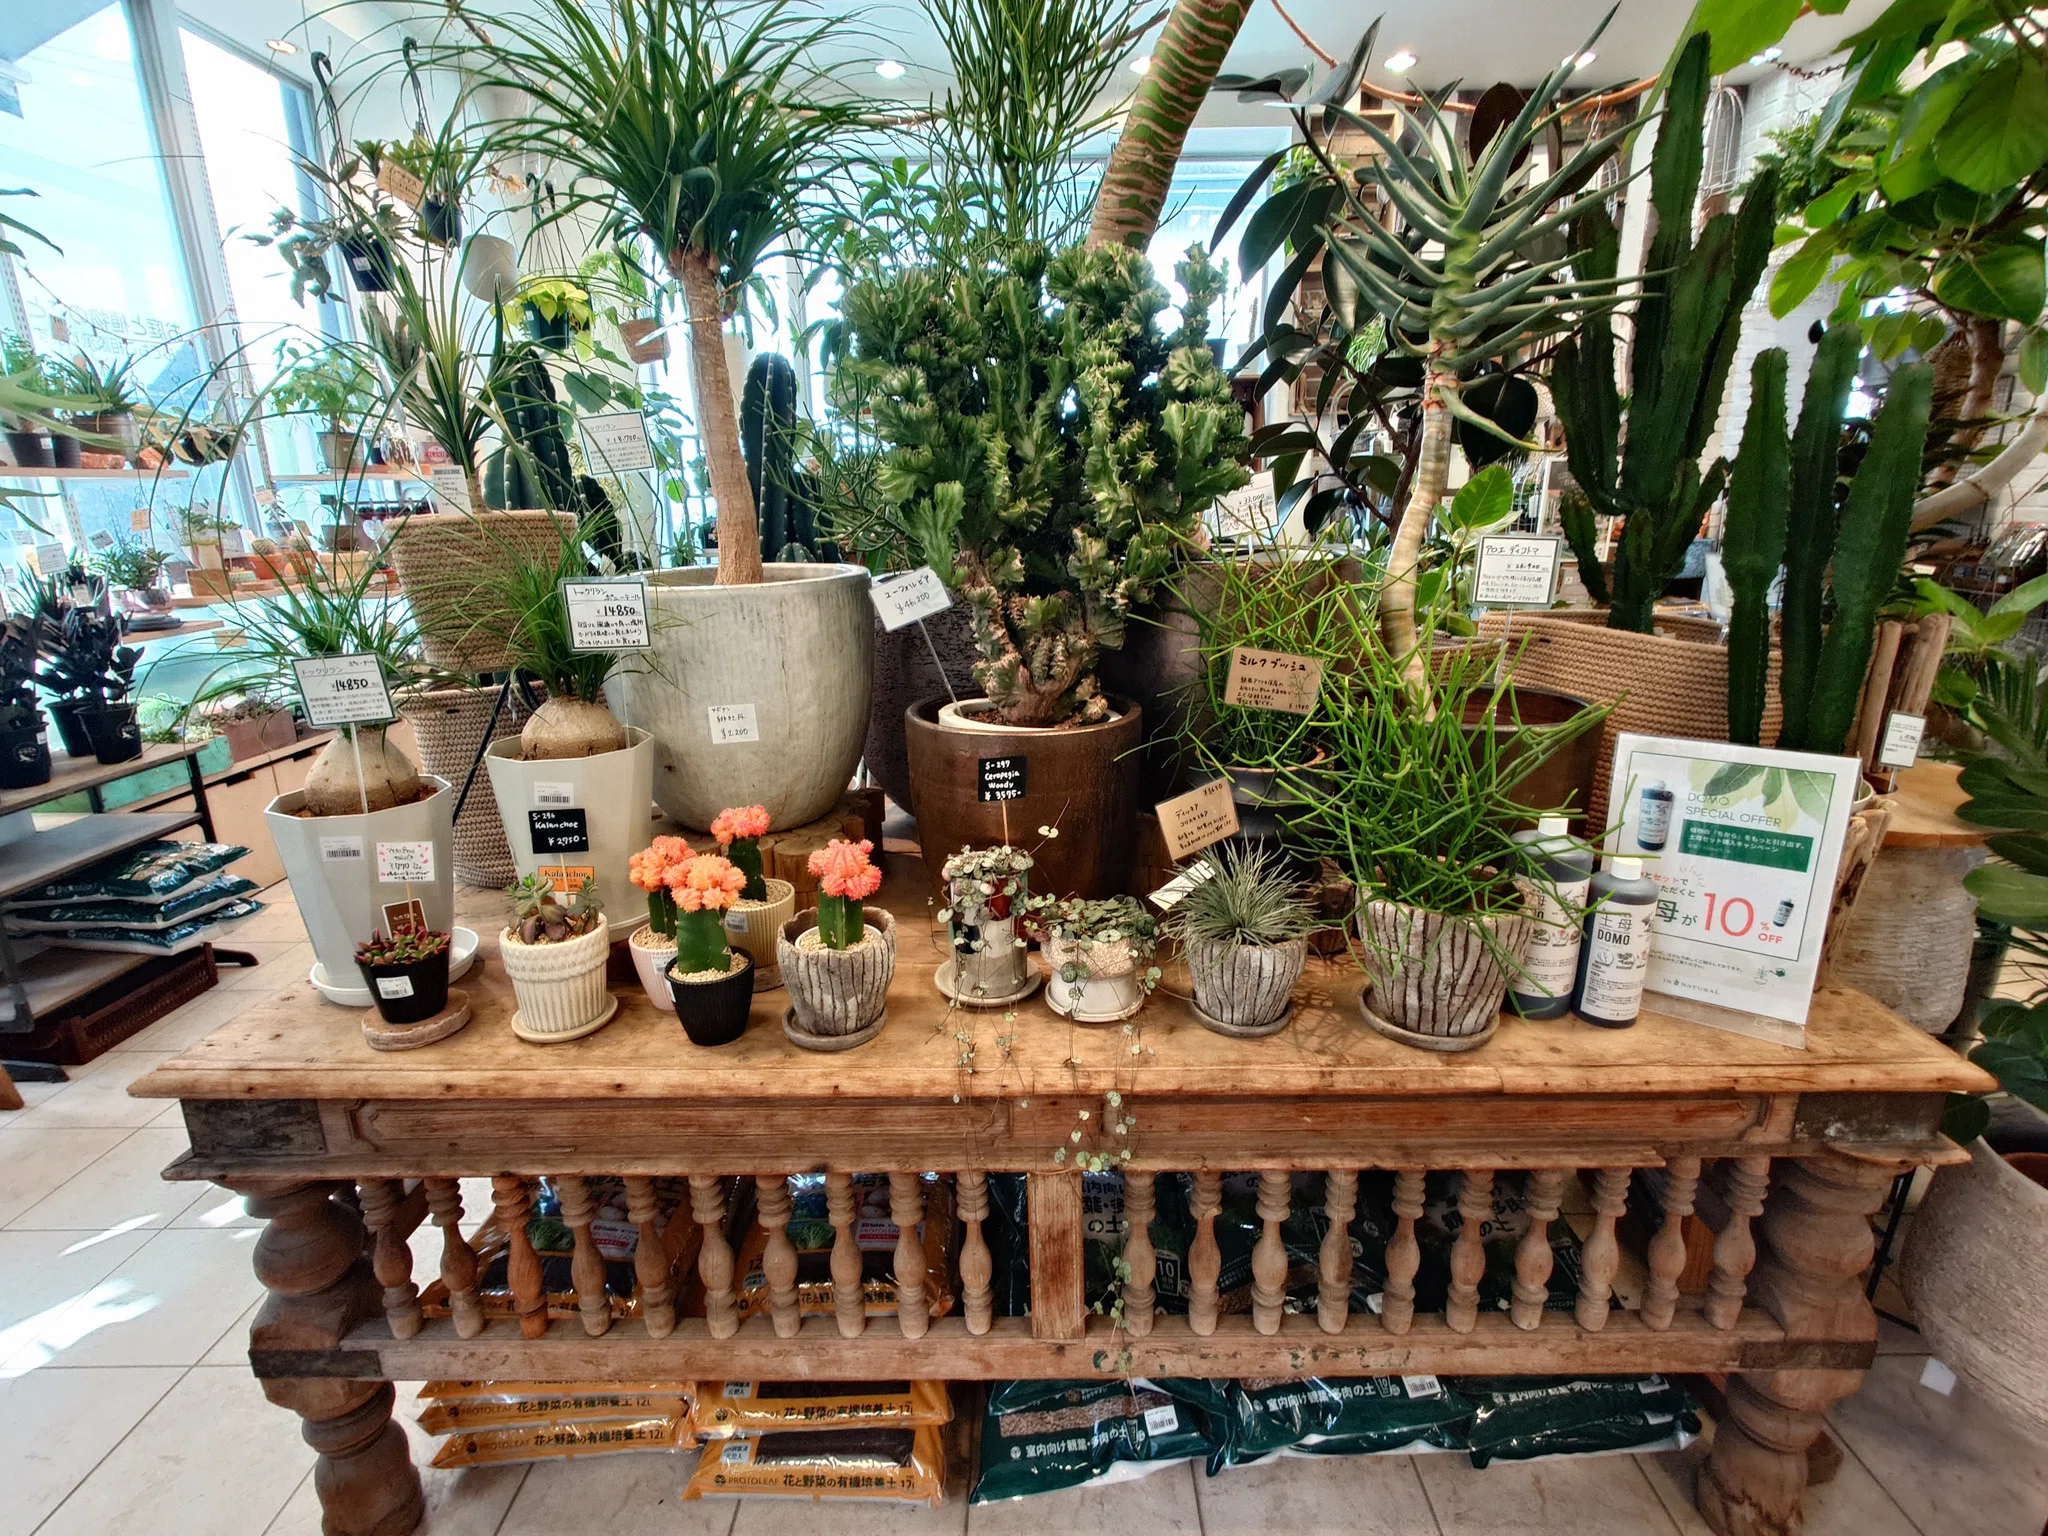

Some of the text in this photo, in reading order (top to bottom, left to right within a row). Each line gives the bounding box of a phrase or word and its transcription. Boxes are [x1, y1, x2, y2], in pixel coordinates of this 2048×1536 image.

[1485, 544, 1539, 555] アロエ ディコトマ
[574, 588, 607, 596] トックリラン
[885, 575, 929, 599] ユーフォルビア
[604, 605, 636, 616] 14850
[302, 668, 343, 676] トックリラン
[984, 759, 1010, 770] S-297
[984, 770, 1020, 781] Ceropegia
[988, 780, 1014, 789] Woody
[984, 791, 991, 801] ¥
[1688, 792, 1730, 805] DOMO
[1685, 806, 1782, 827] SPECIAL OFFER
[535, 821, 579, 829] Kalanchoe
[1640, 871, 1689, 886] とセットで
[1660, 885, 1696, 898] ただくと
[1600, 914, 1632, 931] 土母
[1704, 892, 1755, 938] 10
[1758, 933, 1783, 944] OFF
[1597, 928, 1630, 945] DOMO
[1681, 982, 1720, 996] NATURAL
[1157, 1259, 1175, 1278] 10
[784, 1402, 897, 1420] 花と野菜の有機培養土
[534, 1428, 646, 1446] 花と野菜の有機培養土
[728, 1476, 779, 1486] PROTOLEAF
[783, 1474, 897, 1489] 花と野菜の有機培養土
